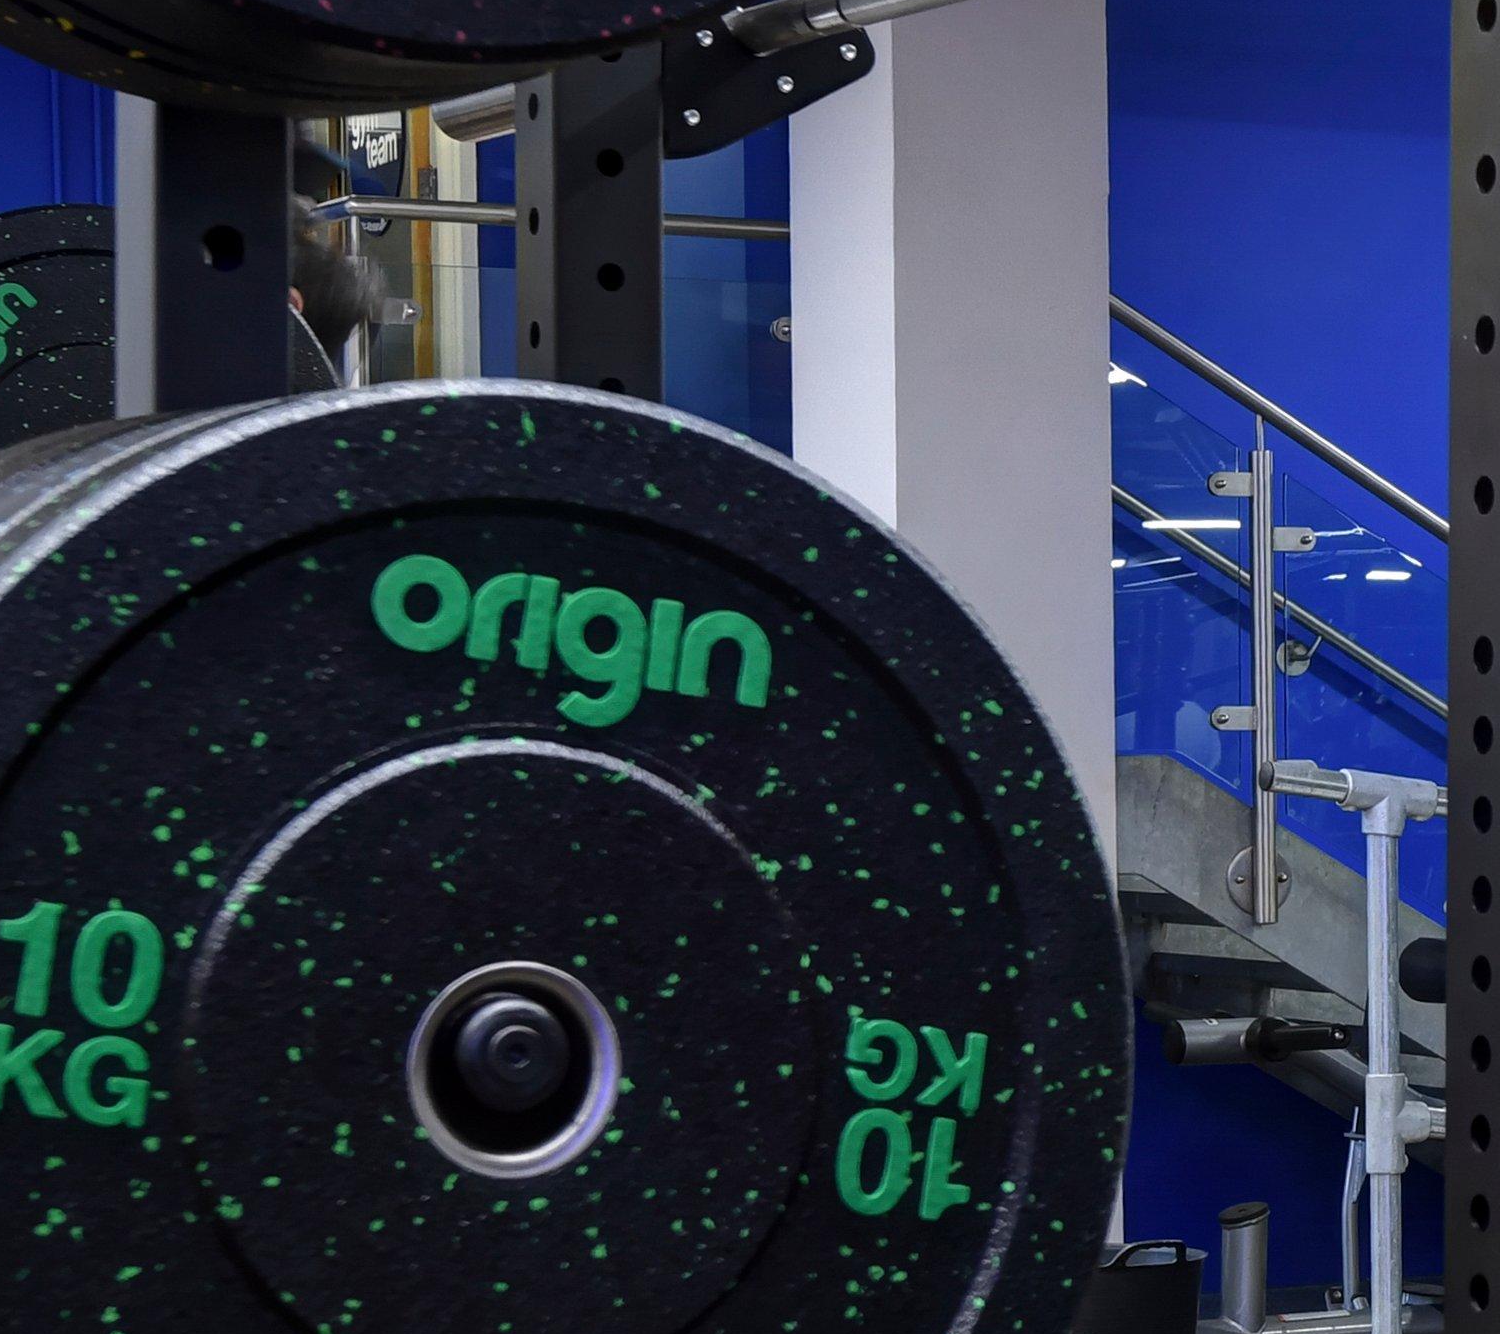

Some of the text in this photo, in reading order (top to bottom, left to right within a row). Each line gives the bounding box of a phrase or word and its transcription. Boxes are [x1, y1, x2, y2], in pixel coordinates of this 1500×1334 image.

[366, 132, 398, 169] team
[370, 553, 773, 728] origin
[842, 1007, 988, 1112] KG
[835, 1107, 972, 1221] 10
